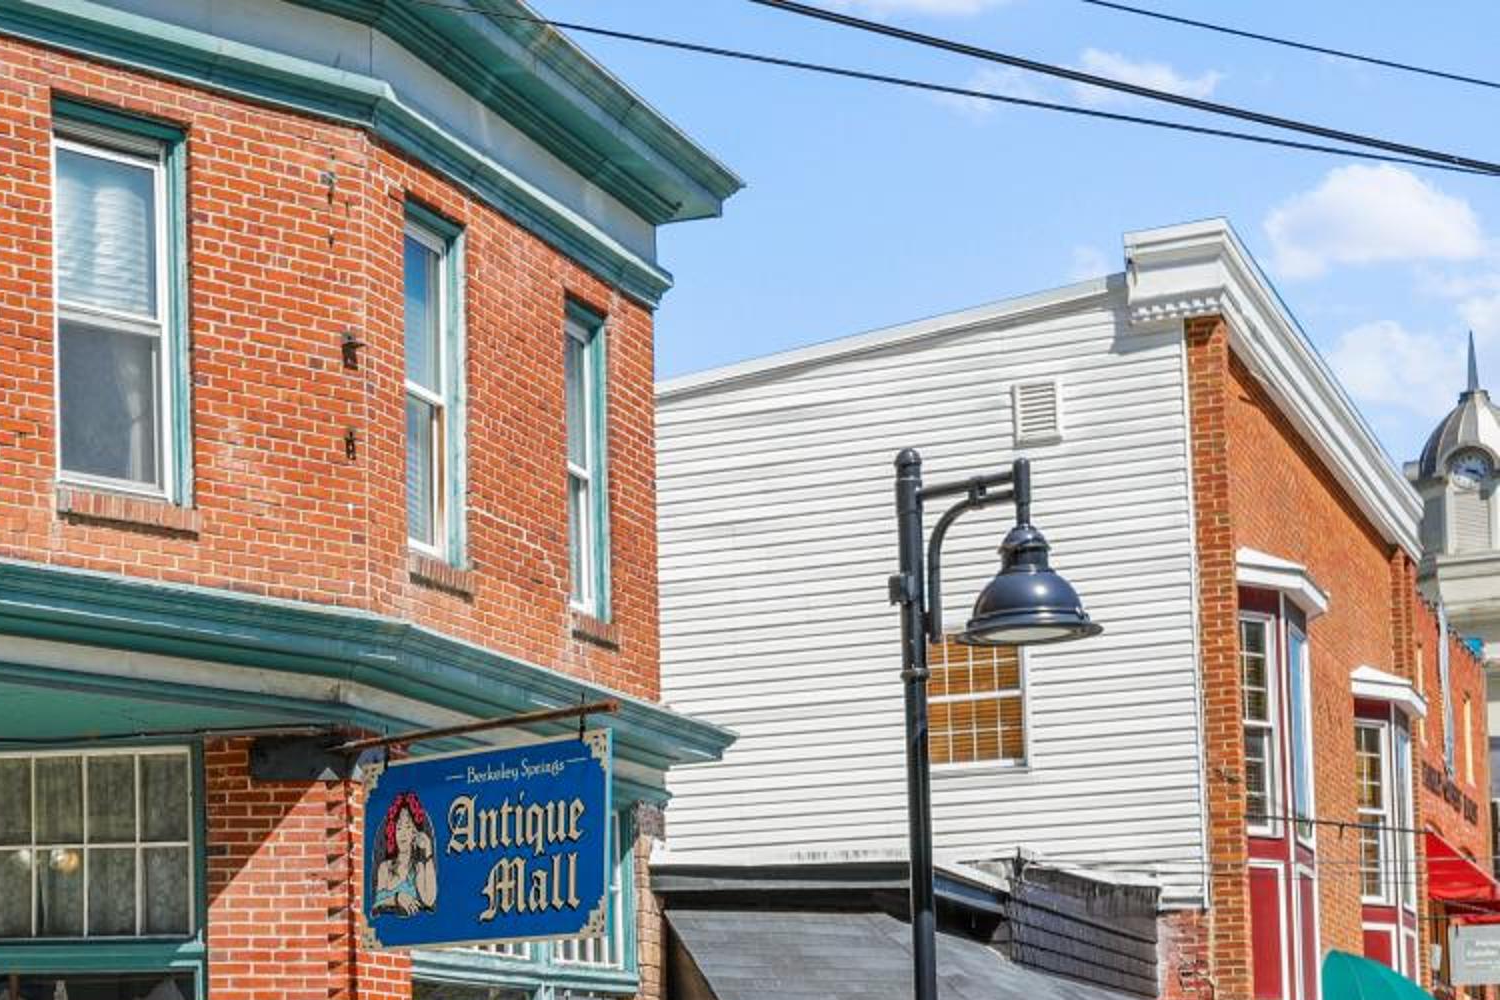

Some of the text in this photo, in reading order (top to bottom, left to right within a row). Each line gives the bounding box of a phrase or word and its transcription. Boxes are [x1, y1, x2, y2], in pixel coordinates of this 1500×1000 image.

[467, 758, 565, 784] Berkeley Springs
[447, 791, 585, 856] Antique
[479, 852, 580, 921] Mall
